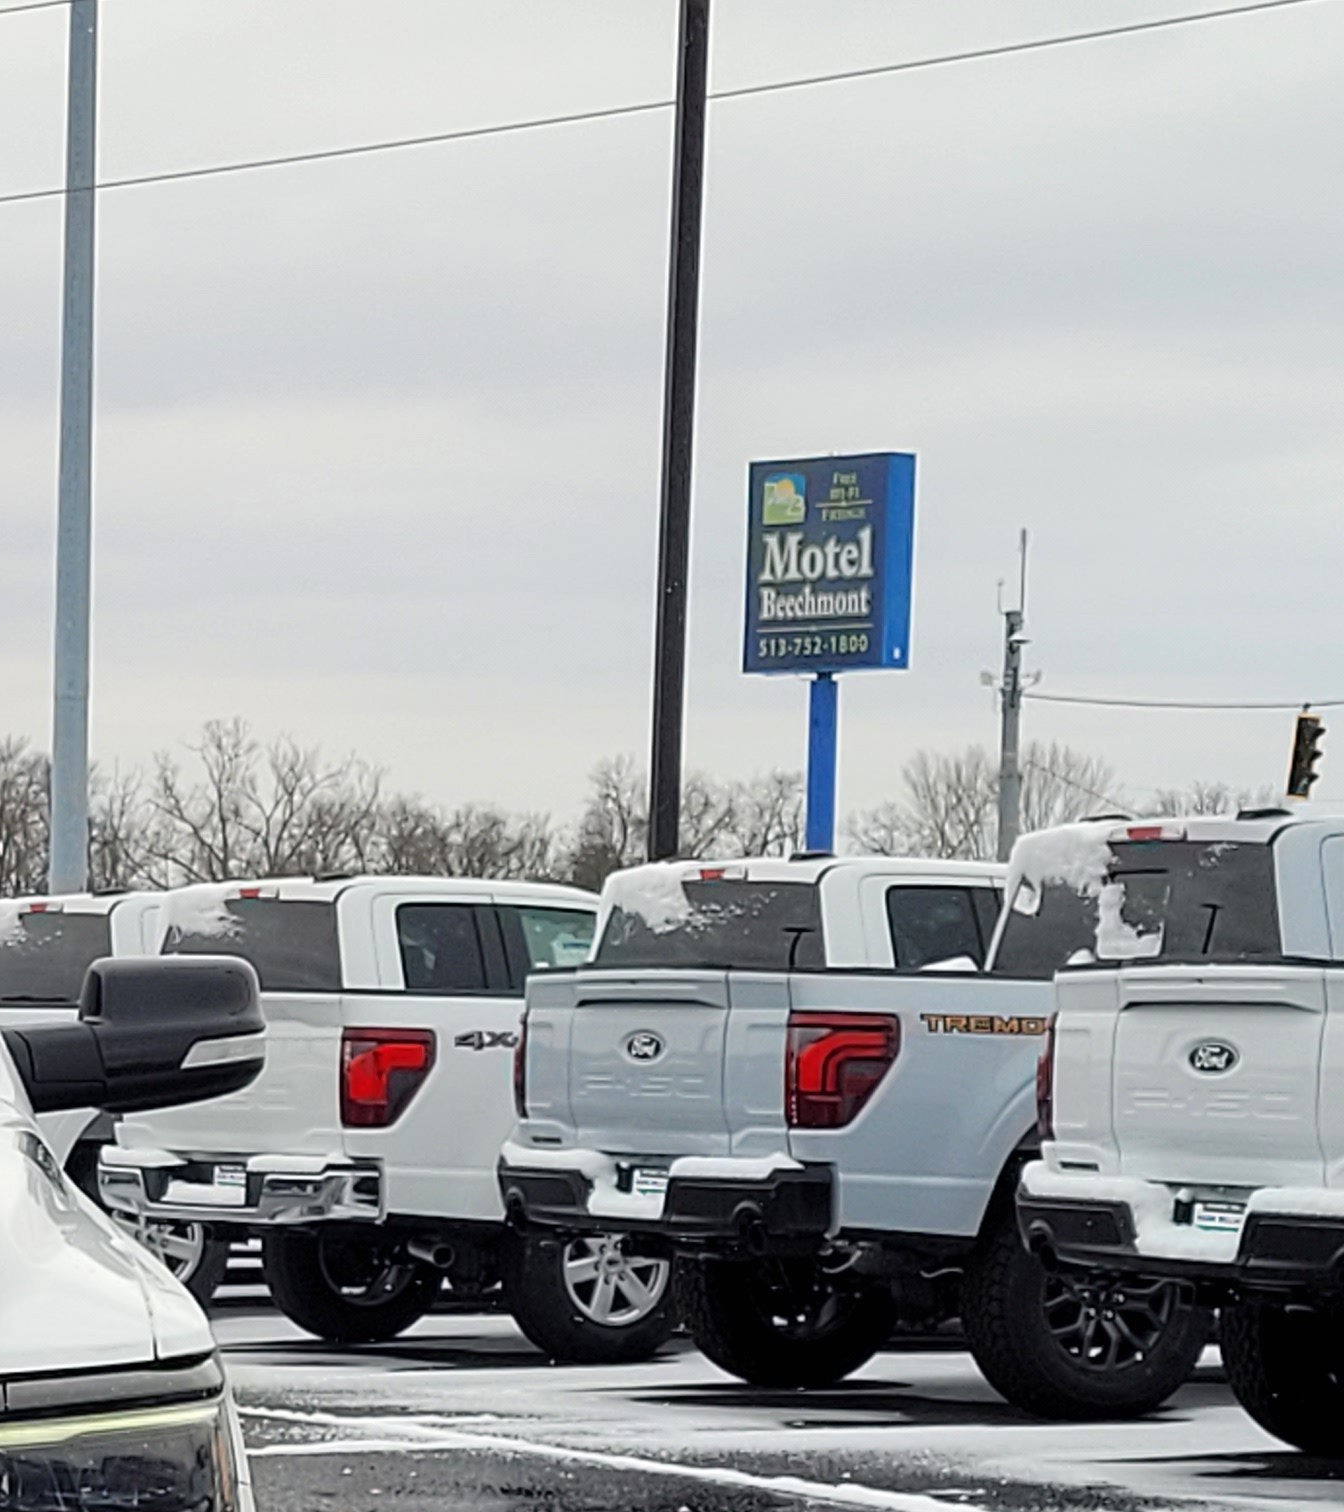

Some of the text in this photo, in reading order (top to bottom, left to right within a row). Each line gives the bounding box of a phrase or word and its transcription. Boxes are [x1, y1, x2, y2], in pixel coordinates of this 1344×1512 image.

[758, 523, 874, 581] Motel
[759, 582, 872, 620] Beechmont
[758, 634, 869, 657] 513-752-1800
[920, 1013, 1048, 1036] TREMO
[454, 1030, 519, 1051] 4X
